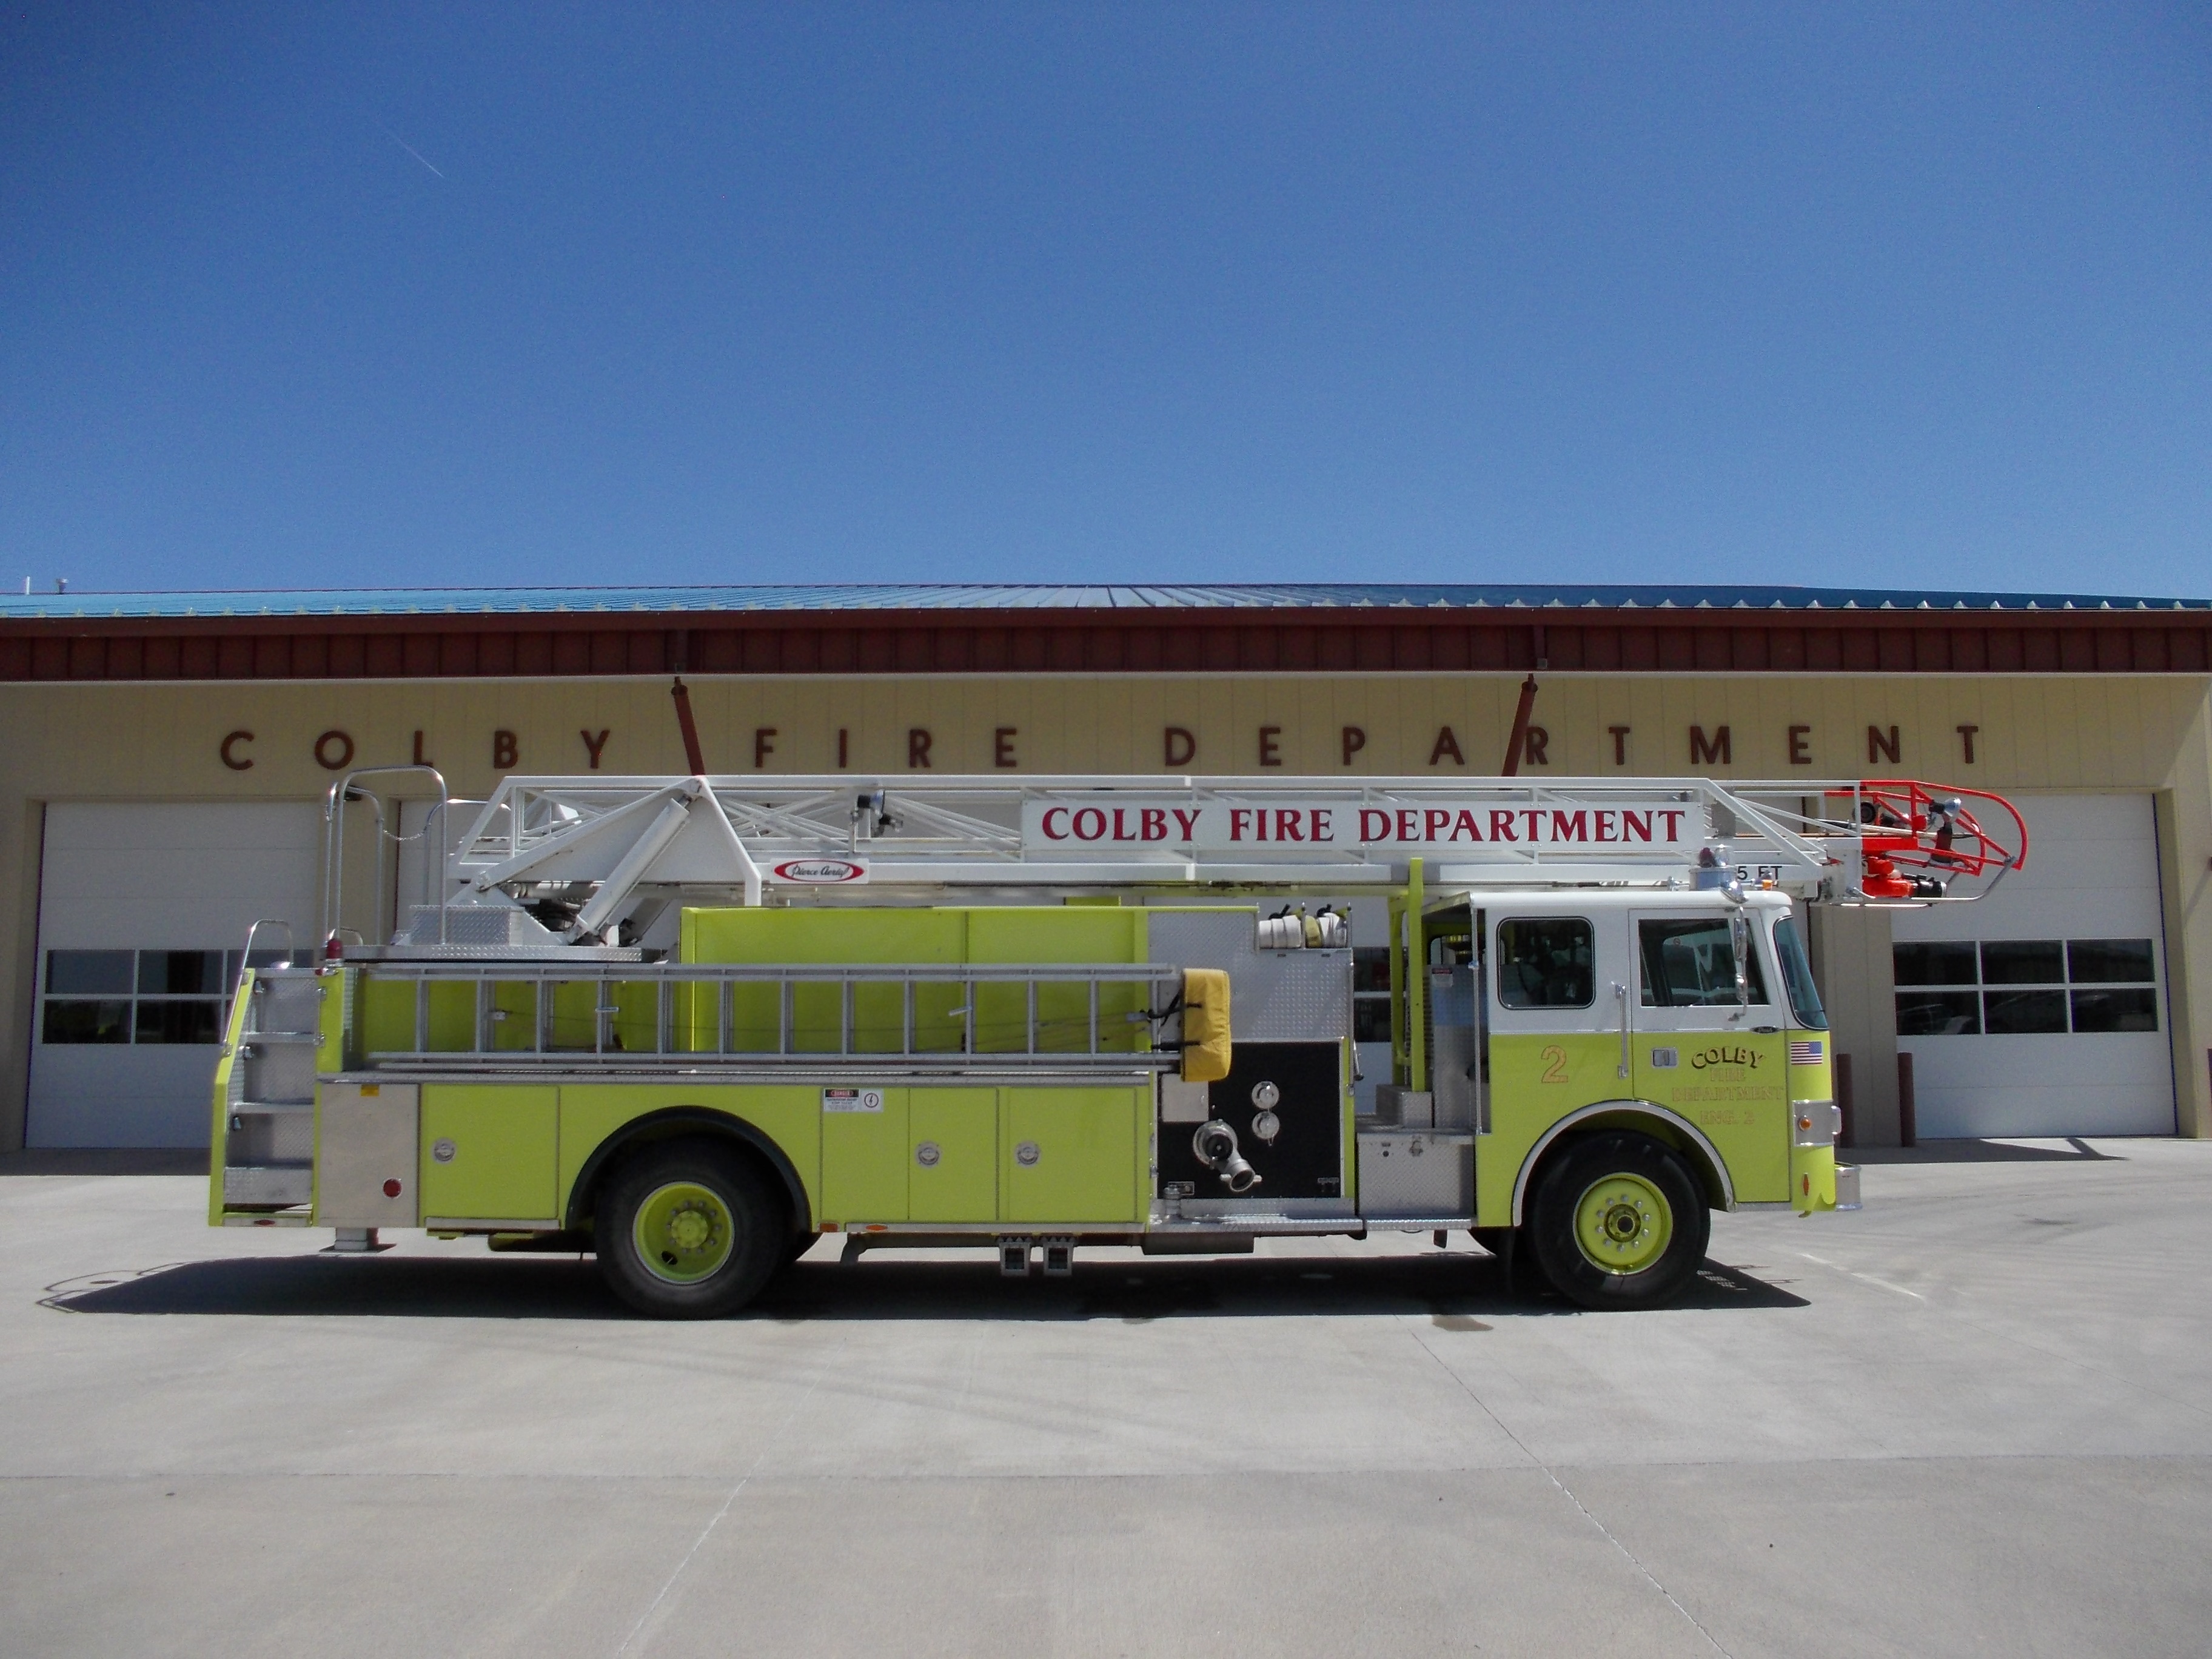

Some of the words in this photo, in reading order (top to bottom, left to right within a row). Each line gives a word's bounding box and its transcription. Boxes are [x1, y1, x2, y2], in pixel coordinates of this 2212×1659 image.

[219, 728, 611, 772] COLBY
[754, 728, 1018, 769] FIRE
[1164, 725, 1980, 768] DEPARTMENT
[1041, 806, 1203, 842] COLBY
[1230, 808, 1334, 842] FIRE
[1358, 808, 1686, 843] DEPARTMENT
[792, 864, 818, 877] Pierce
[1541, 1045, 1568, 1083] 2
[1691, 1046, 1765, 1069] COLBY
[1672, 1087, 1785, 1102] DEPARTMENT
